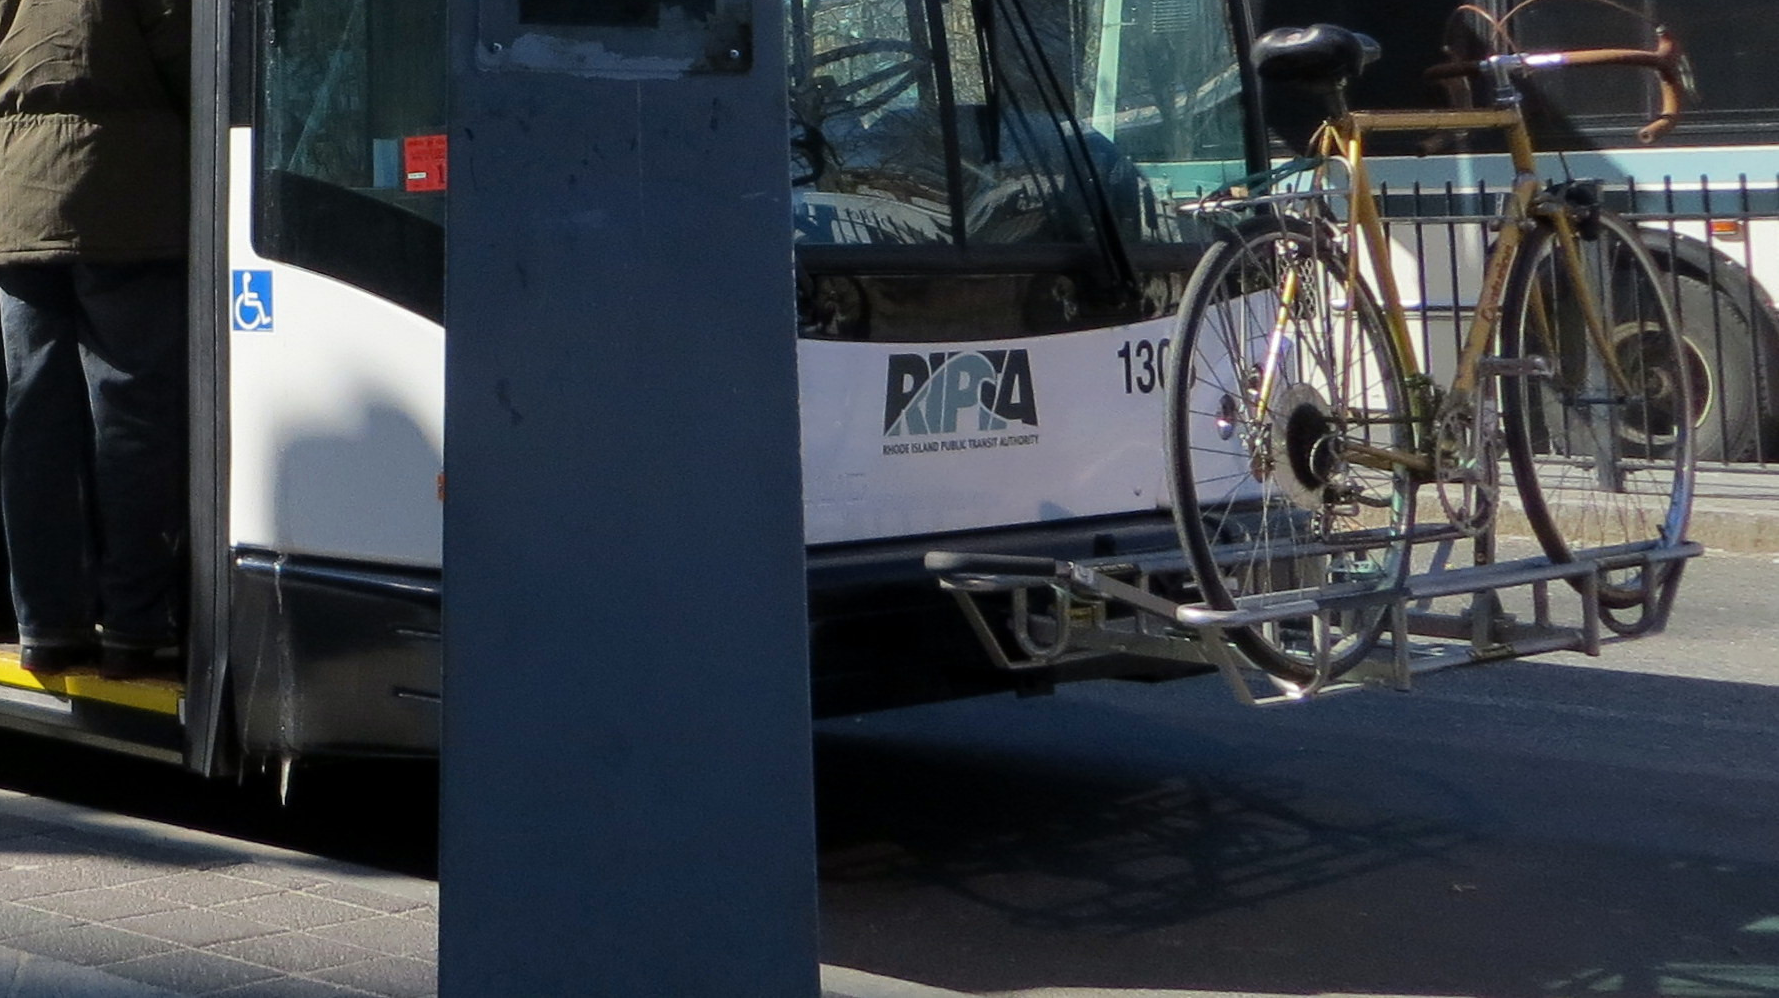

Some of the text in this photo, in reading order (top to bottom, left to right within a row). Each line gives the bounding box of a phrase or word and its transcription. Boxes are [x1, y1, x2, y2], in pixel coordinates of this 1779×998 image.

[884, 348, 1039, 437] RIPTA
[1117, 338, 1196, 394] 130
[882, 433, 1040, 456] RHODE ISLAND PUBLIC TRANSIT AUTHORITY
